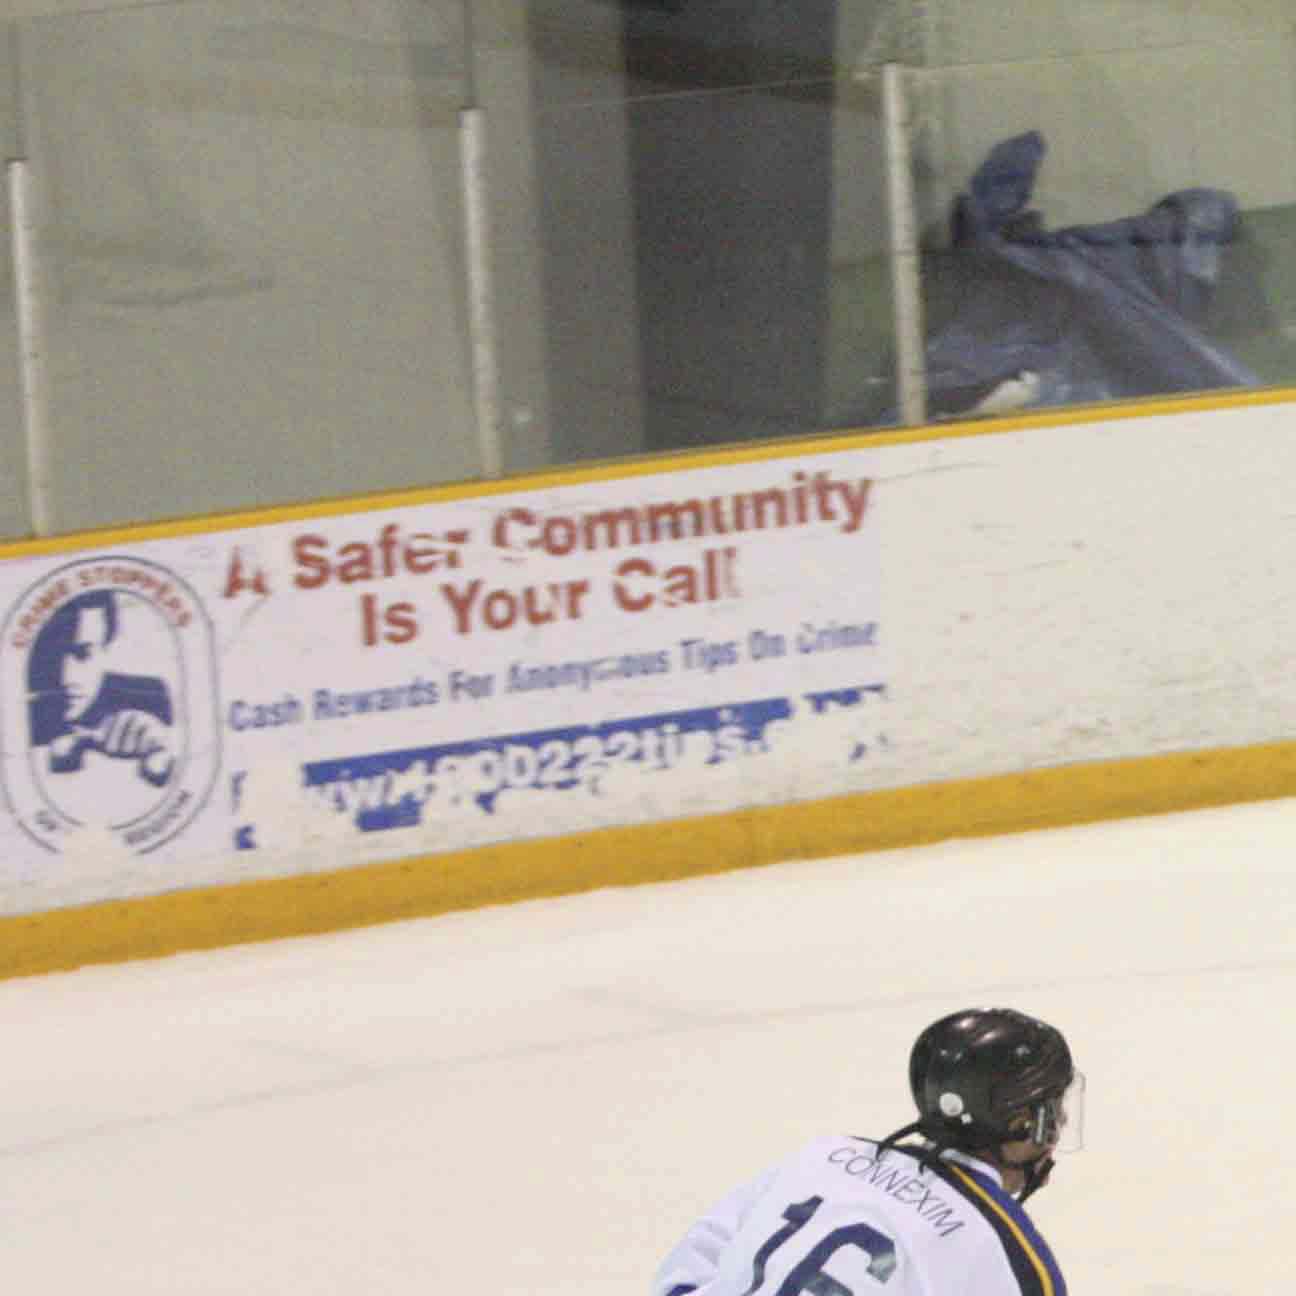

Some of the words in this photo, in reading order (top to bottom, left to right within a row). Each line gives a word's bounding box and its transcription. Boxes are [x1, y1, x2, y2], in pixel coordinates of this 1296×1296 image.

[292, 523, 470, 590] Safer
[491, 470, 874, 562] Community
[360, 592, 419, 647] Is
[439, 577, 589, 635] Your
[612, 546, 740, 613] Call
[229, 693, 304, 732] Cash
[312, 675, 439, 721] Rewards
[449, 670, 496, 701] For
[680, 637, 739, 673] Tips
[828, 1147, 965, 1238] CONNEXIM
